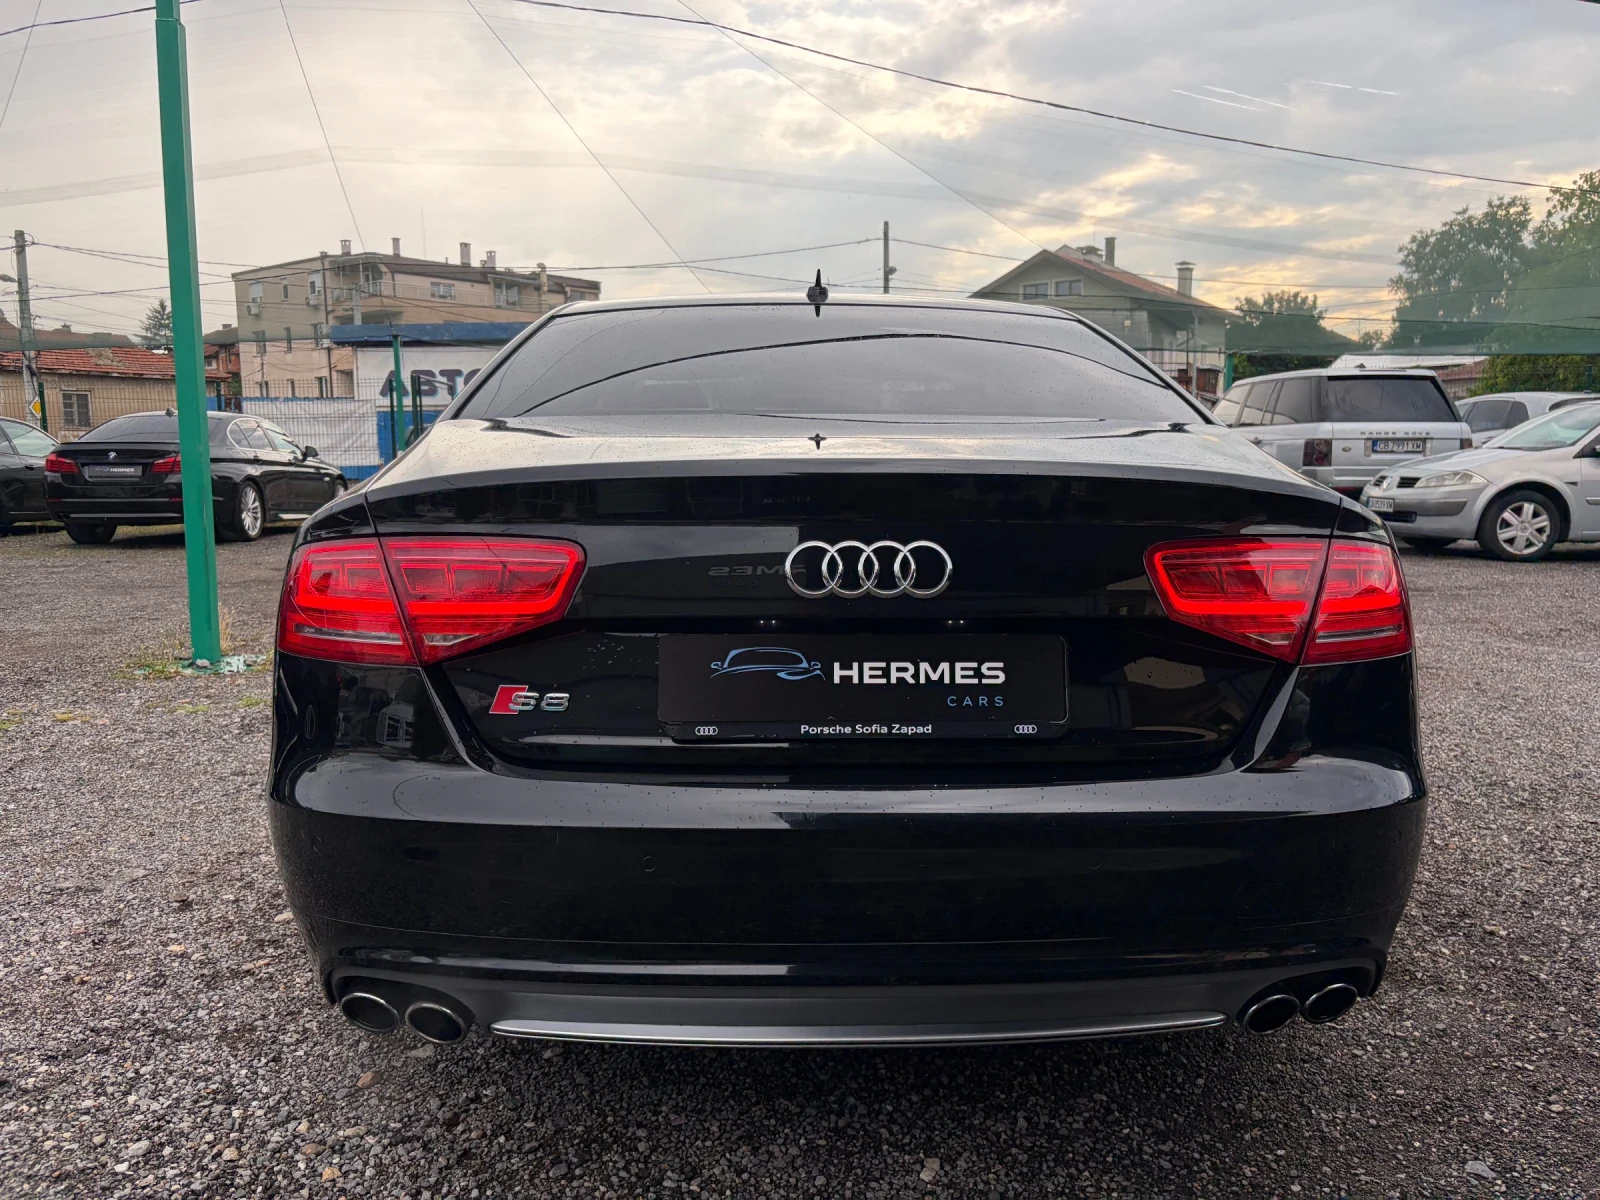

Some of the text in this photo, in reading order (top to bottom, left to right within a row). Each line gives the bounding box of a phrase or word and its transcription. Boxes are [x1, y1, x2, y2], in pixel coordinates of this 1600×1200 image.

[833, 661, 1006, 684] HERMES
[508, 691, 570, 711] S8
[947, 696, 1004, 707] CARS
[800, 724, 932, 736] Porsche Sofia Zapad
